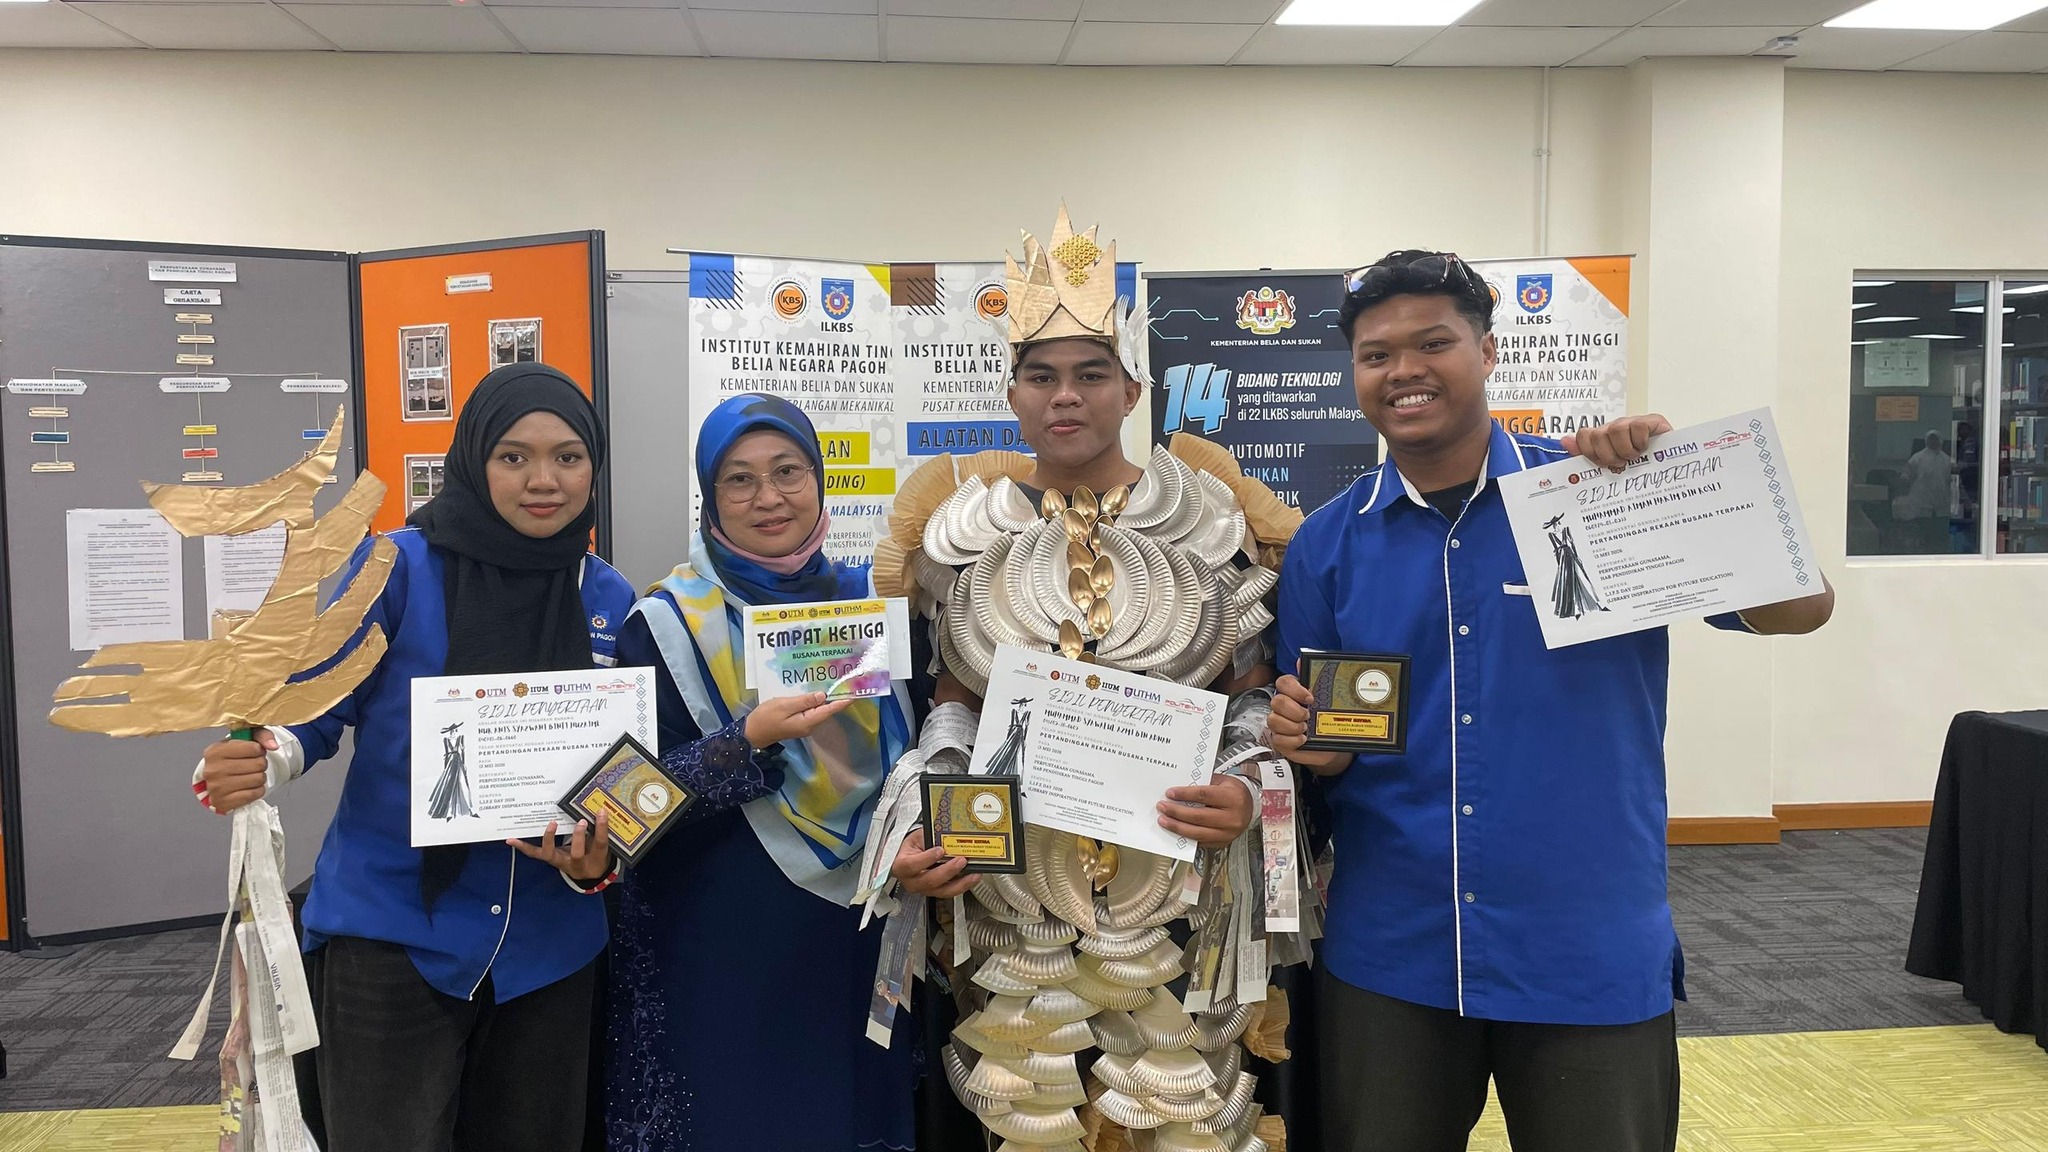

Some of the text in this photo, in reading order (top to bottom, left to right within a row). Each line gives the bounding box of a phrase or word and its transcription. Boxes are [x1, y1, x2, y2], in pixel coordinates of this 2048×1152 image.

[782, 296, 801, 305] KBS
[986, 299, 1005, 308] KBS
[1516, 315, 1552, 325] ILKBS
[820, 322, 853, 333] ILKBS
[1566, 333, 1618, 347] TINGGI
[702, 339, 771, 355] INSTITUT
[777, 341, 860, 358] KEMAHIRAN
[904, 344, 973, 358] INSTITUT
[1538, 349, 1588, 363] PAGOH
[732, 357, 886, 374] BELIA NEGARA PAGOH
[934, 360, 977, 374] BELIA
[1236, 372, 1342, 388] BIDANG TEKNOLOGI
[1495, 369, 1597, 383] BELIA DAN SUKAN
[720, 378, 894, 394] KEMENTERIAN BELIA DAN SUKAN
[923, 381, 997, 393] KEMENTERIA
[1163, 363, 1232, 435] 14
[1237, 391, 1316, 406] yang ditawarkan
[1537, 388, 1598, 400] MEKANIKAL
[840, 400, 894, 412] MEKANIKAL
[922, 401, 955, 412] PUSAT
[1237, 409, 1247, 421] di
[1248, 409, 1260, 421] 22
[1262, 408, 1289, 421] ILKBS
[1290, 408, 1327, 420] seluruh
[919, 428, 994, 449] ALATAN
[1703, 432, 1753, 449] POLITEKNIK
[1229, 443, 1305, 459] AUTOMOTIF
[1663, 442, 1698, 457] UTHM
[1243, 467, 1289, 482] SUKAN
[1576, 482, 1620, 506] SIJIL
[1625, 455, 1723, 494] PENYERTAAN
[1580, 467, 1602, 480] UTM
[830, 505, 883, 516] MALAYSIA
[1582, 506, 1626, 523] MUHAMMAD
[1628, 500, 1653, 513] AIMAN
[1654, 493, 1681, 507] HAKIM
[1682, 488, 1697, 499] BIN
[1589, 502, 1755, 546] PERTANDINGAN REKAAN BUSANA TERPAKAI
[833, 532, 872, 540] BERPERISAI)
[826, 540, 874, 549] TUNGSTEN GAS)
[1598, 562, 1639, 575] PERPUSTAKAAN
[1612, 567, 1645, 579] PENDIDIKAN
[1645, 562, 1665, 572] TINGGI
[1665, 558, 1685, 568] PAGOH
[1606, 572, 1734, 604] (LIBRARY INSPIRATION FOR FUTURE EDUCATION)
[1620, 586, 1632, 595] DAY
[787, 609, 804, 618] UTM
[840, 604, 862, 614] UTHM
[757, 621, 884, 649] TEMPAT KETIGA
[792, 648, 853, 660] BUSANA TERPAKAI
[1061, 673, 1080, 683] UTM
[487, 688, 506, 697] UTM
[563, 683, 592, 692] UTHM
[596, 683, 637, 691] POLITEKNIK
[1101, 681, 1120, 691] IIUM
[1132, 688, 1161, 703] UTHM
[478, 698, 608, 720] SIJIL PENYERTAAN
[1048, 688, 1087, 708] SIJIL
[1088, 697, 1174, 726] PENYERTAAN
[1164, 698, 1205, 714] POLITEKNIK
[512, 723, 547, 733] SYAZWANI
[1044, 709, 1081, 723] MUHAMMAD
[1135, 730, 1149, 741] BIN
[478, 748, 532, 756] PERTANDINGAN
[1039, 732, 1178, 770] PERTANDINGAN REKAAN BUSANA TERPAKAI
[1033, 759, 1068, 772] PERPUSTAKAAN
[1273, 766, 1285, 779] up
[478, 776, 517, 784] PERPUSTAKAAN
[1042, 767, 1071, 779] PENDIDIKAN
[1048, 791, 1078, 804] INSPIRATION
[1078, 797, 1088, 805] FOR
[1088, 799, 1106, 810] FUTURE
[1106, 803, 1135, 817] EDUCATION)
[271, 962, 281, 991] VISTRA
